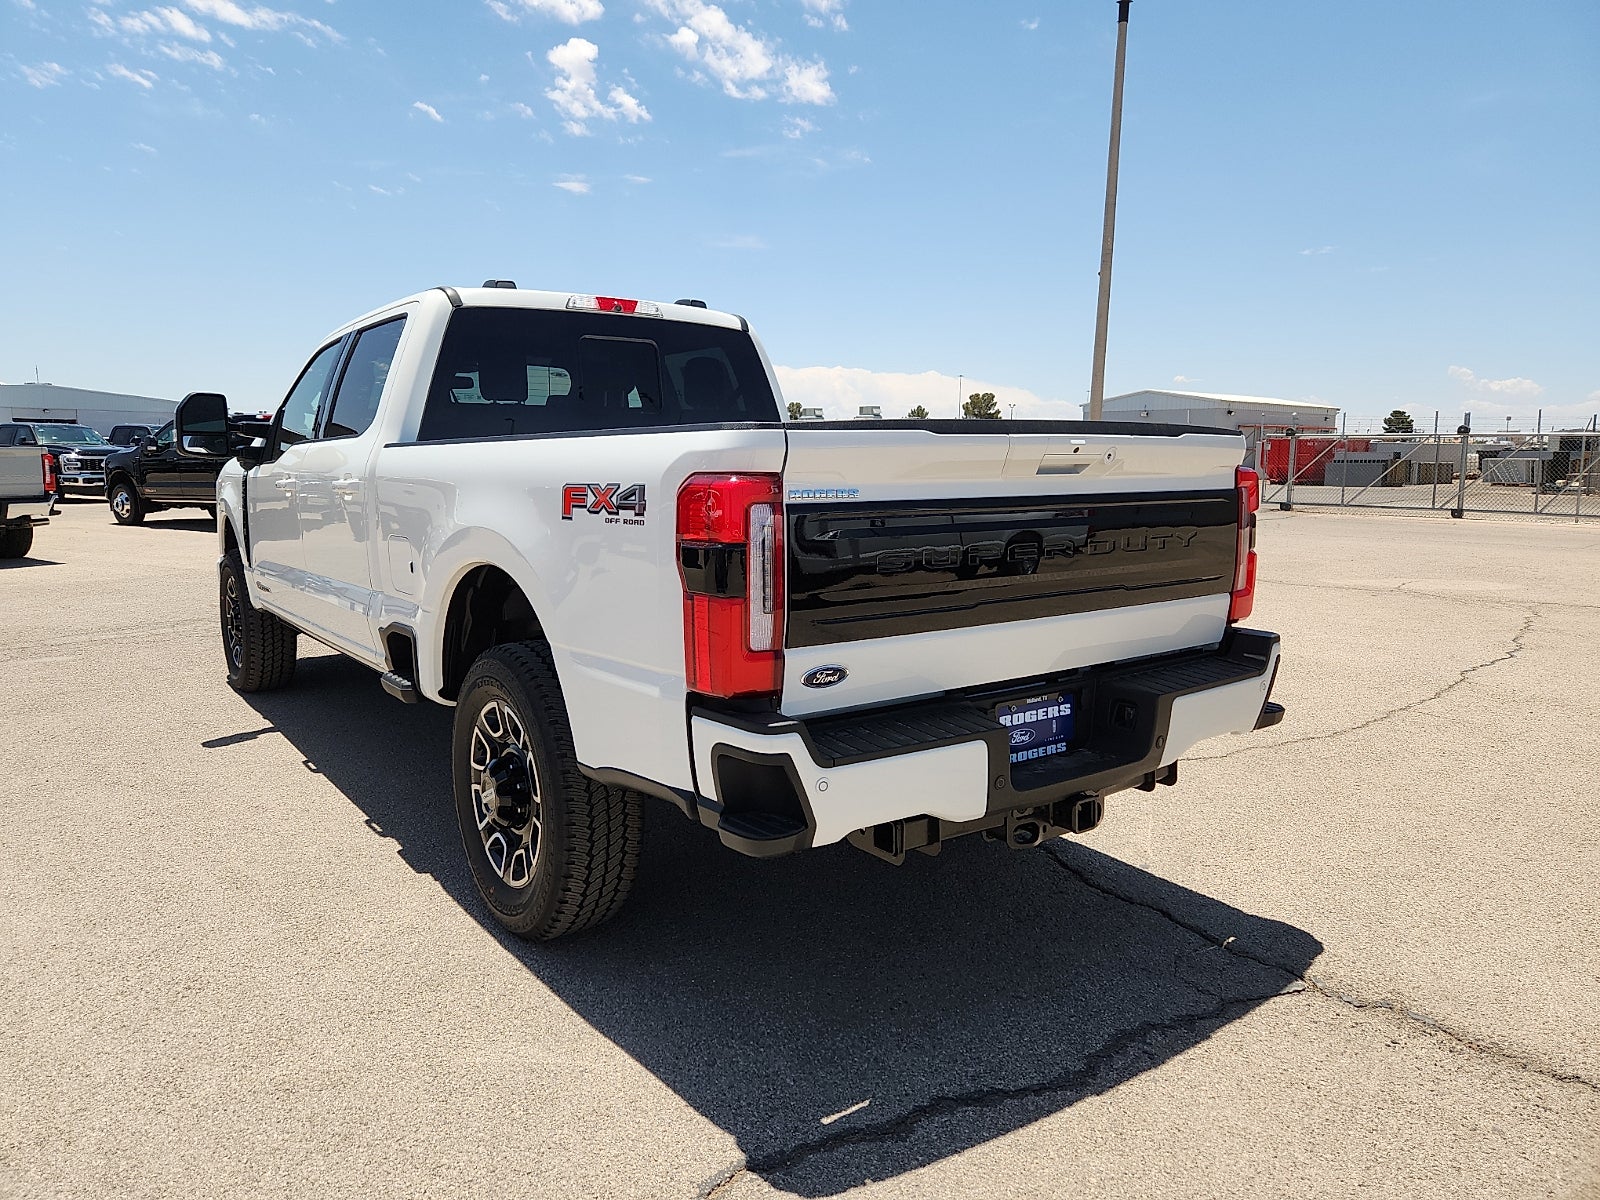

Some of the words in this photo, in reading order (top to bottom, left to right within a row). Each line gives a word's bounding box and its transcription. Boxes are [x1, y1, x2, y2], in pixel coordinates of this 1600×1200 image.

[562, 483, 646, 520] FX4
[788, 489, 860, 500] ROGERS
[623, 518, 645, 526] ROAD
[876, 540, 1076, 573] SUPER
[1087, 530, 1198, 556] DUTY
[812, 670, 840, 684] Ford
[999, 703, 1072, 727] ROGERS
[1011, 730, 1031, 744] Ford
[1009, 742, 1067, 764] ROGERS
